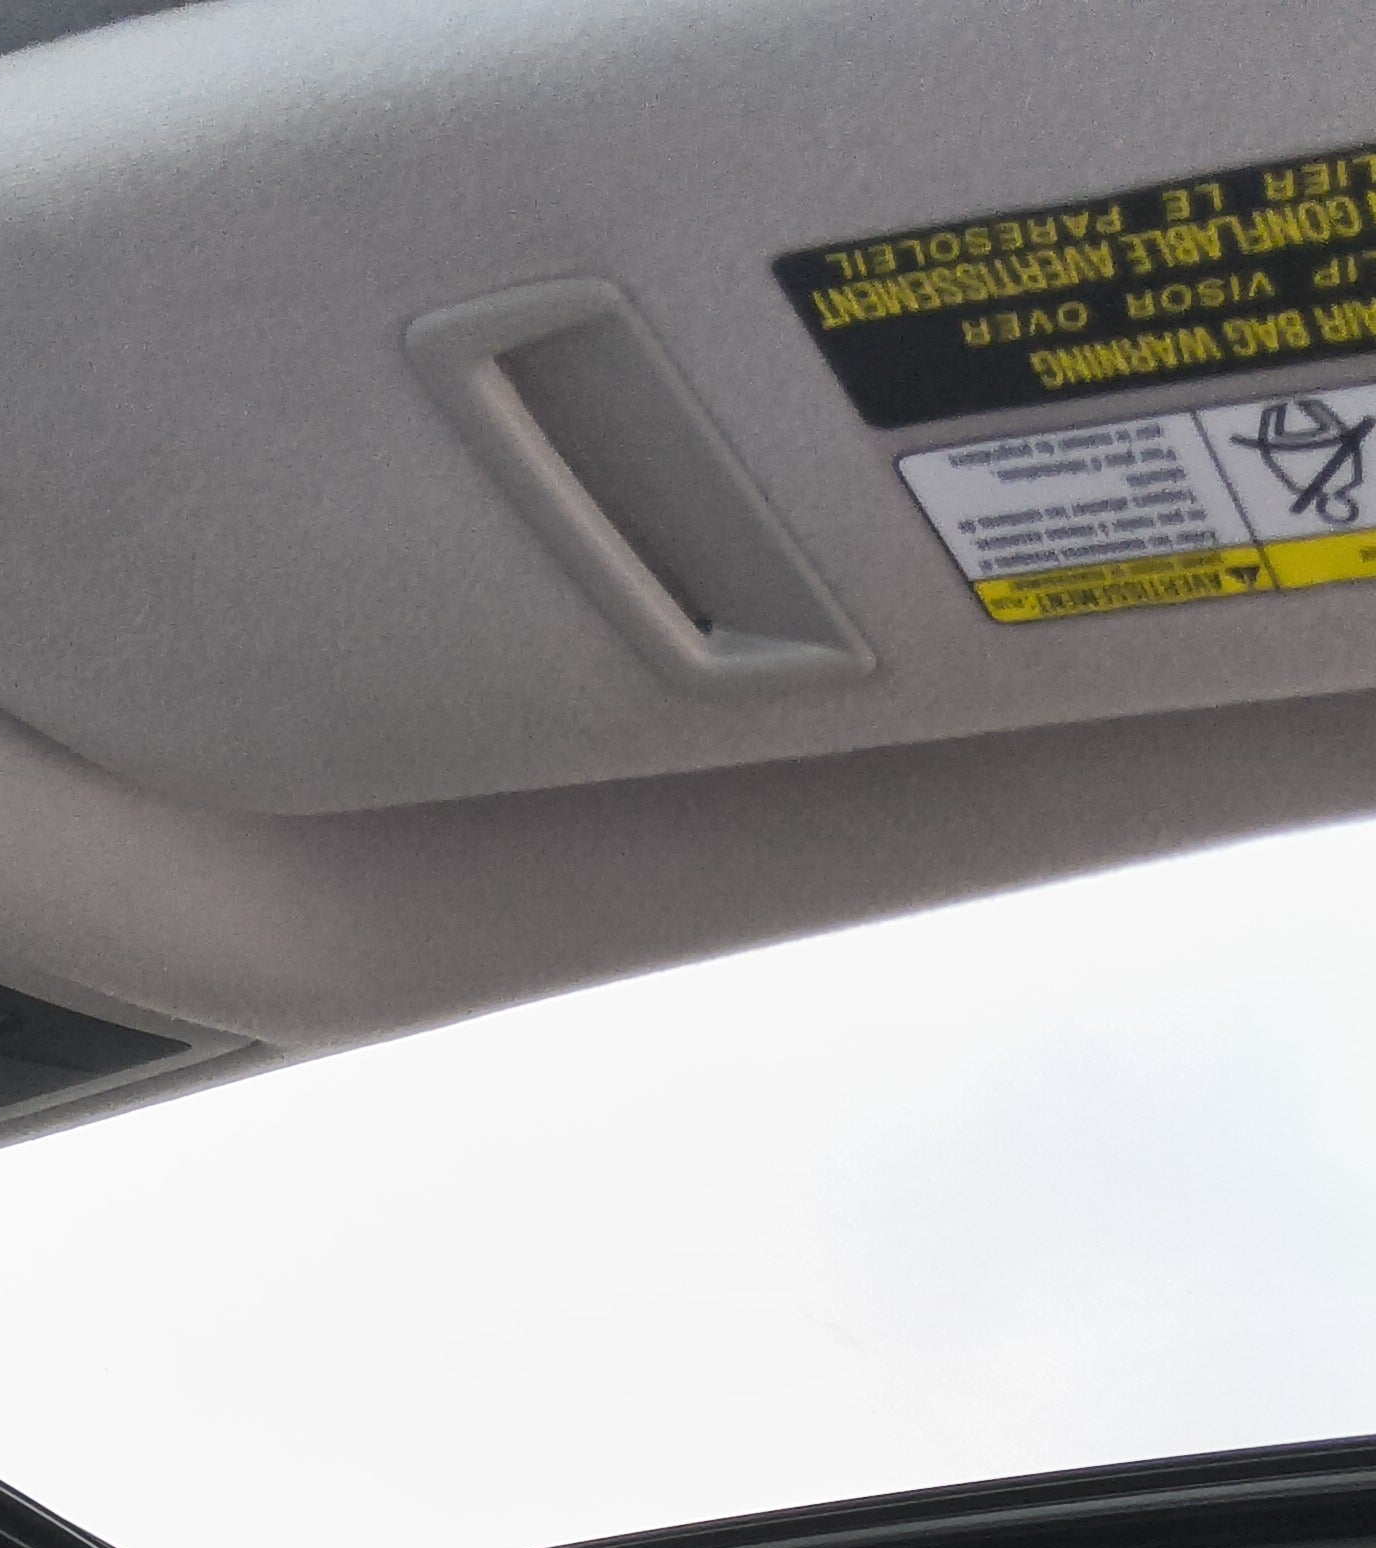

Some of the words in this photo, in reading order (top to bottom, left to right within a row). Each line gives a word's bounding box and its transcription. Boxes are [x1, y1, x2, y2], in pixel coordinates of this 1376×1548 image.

[1161, 182, 1224, 221] LE
[824, 203, 1124, 280] PARESOLEIL
[1119, 196, 1362, 275] GONFLABLE
[811, 240, 1116, 331] AVERTISSEMENT
[1125, 271, 1276, 321] VISOR
[961, 300, 1088, 348] OVER
[1222, 309, 1310, 357] BAG
[1029, 326, 1221, 390] WARNING
